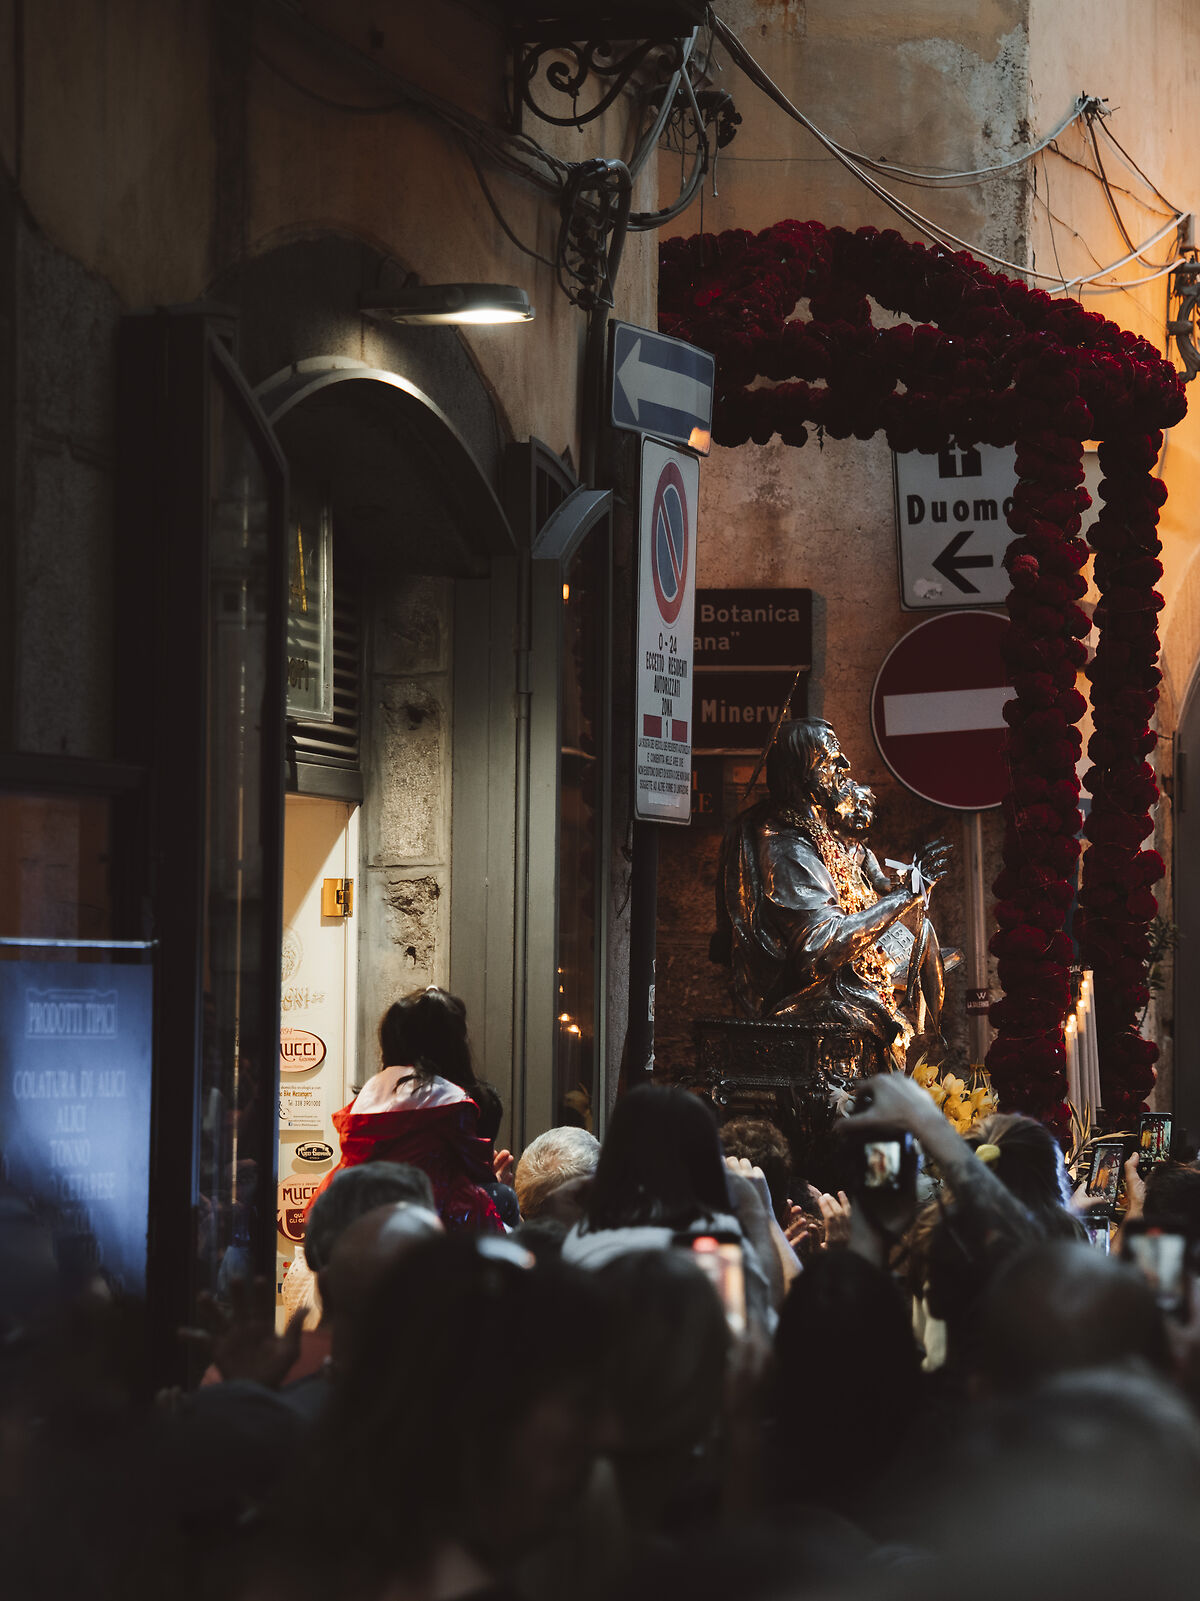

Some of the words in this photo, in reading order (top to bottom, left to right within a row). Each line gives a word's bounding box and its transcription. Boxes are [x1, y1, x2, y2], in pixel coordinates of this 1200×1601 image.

[700, 603, 800, 623] Botanica
[669, 635, 677, 655] 24
[645, 651, 664, 673] ECCETTO
[668, 656, 688, 678] RESIDENTI
[653, 674, 681, 697] AUTORIZZATI
[661, 697, 673, 717] ZONA
[701, 699, 792, 724] Minerva
[28, 1003, 83, 1034] PRODOTTI
[282, 1187, 320, 1205] MUCC
